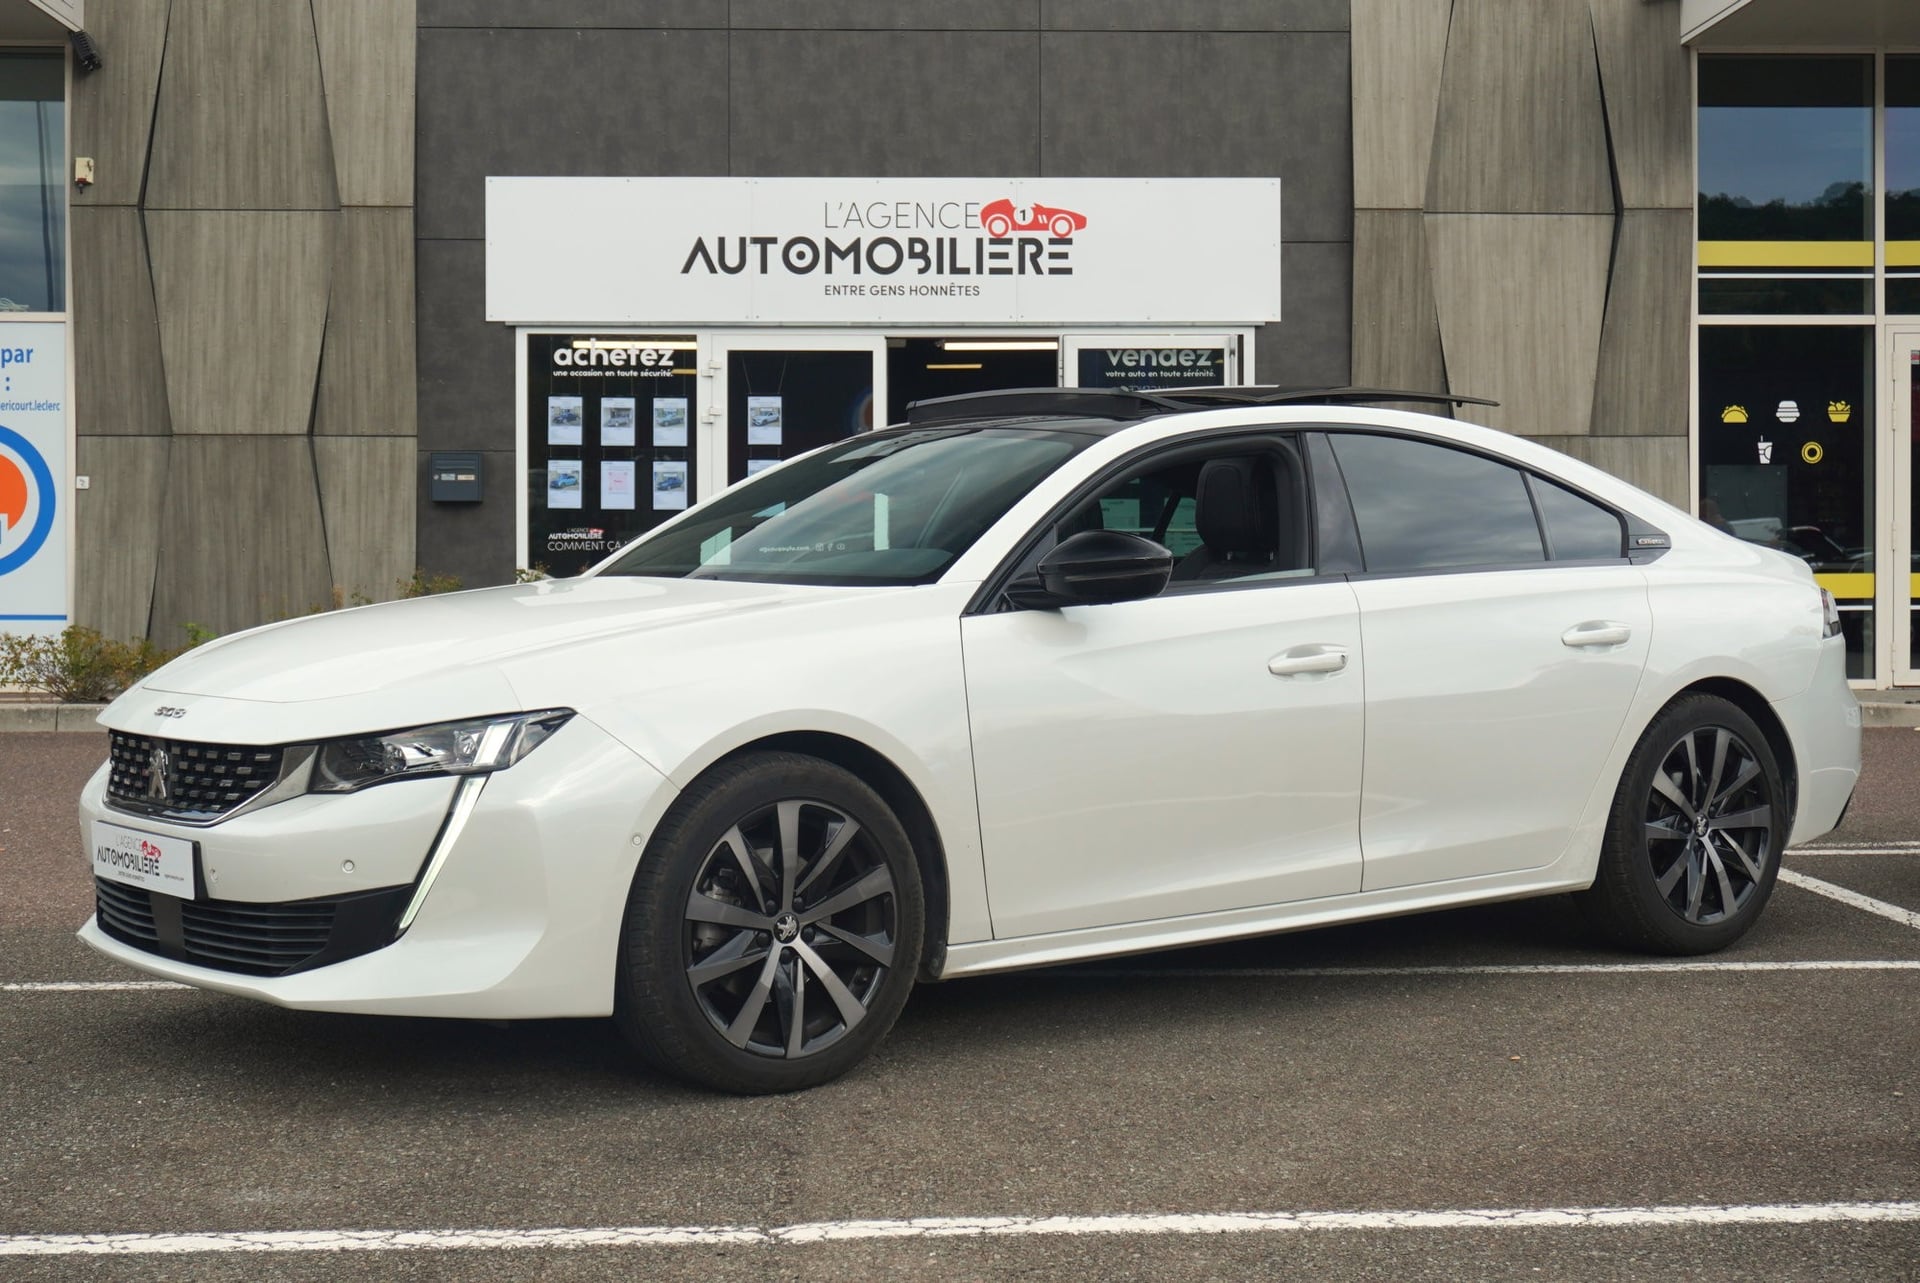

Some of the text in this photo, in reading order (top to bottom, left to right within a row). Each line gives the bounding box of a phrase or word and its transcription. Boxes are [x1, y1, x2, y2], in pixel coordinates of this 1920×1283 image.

[824, 201, 981, 229] L'AGENCE
[1019, 208, 1027, 222] 1
[824, 282, 981, 297] ENTRE GENS HONNÊTES
[1, 347, 34, 369] par
[553, 337, 675, 367] achetez
[569, 368, 603, 377] occasion
[616, 368, 639, 377] toute
[1105, 368, 1217, 378] votre auto en toute sérénité.
[547, 541, 621, 553] COMMENT ÇA
